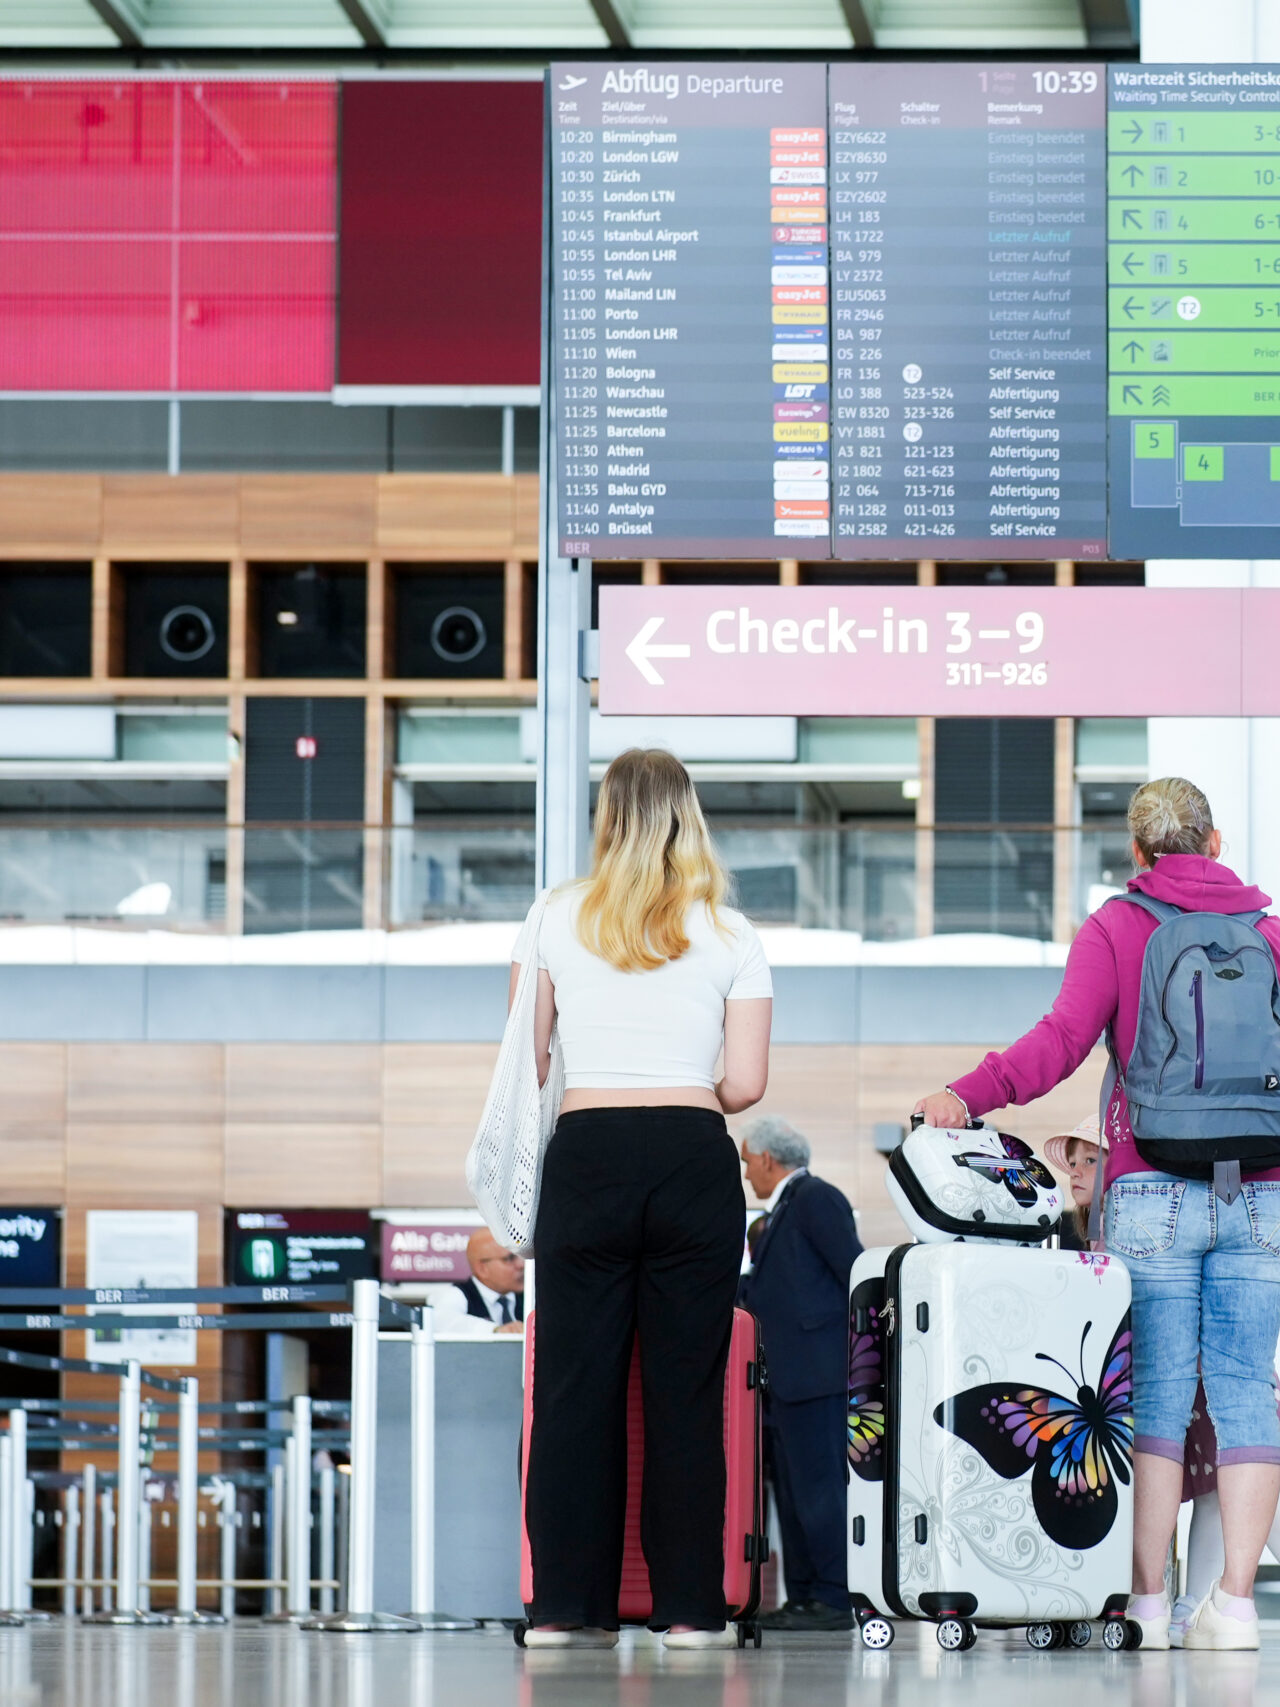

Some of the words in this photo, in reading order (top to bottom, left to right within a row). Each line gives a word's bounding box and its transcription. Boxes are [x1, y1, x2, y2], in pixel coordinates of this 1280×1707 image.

[602, 69, 679, 99] Abflug
[1032, 71, 1097, 93] 10:39
[1114, 72, 1184, 85] Wartezeit
[687, 75, 783, 98] Departure
[1114, 91, 1157, 104] Waiting
[1191, 91, 1236, 105] Security
[1239, 91, 1280, 102] Control
[559, 102, 577, 111] Zeit
[602, 102, 646, 112] Ziel/über
[835, 102, 856, 114] Flug
[901, 102, 940, 112] Schalter
[988, 102, 1043, 114] Bemerkung
[561, 131, 593, 143] 10:20
[603, 130, 677, 146] Birmingham
[775, 132, 819, 145] easyJet
[835, 132, 886, 144] EZY6622
[1178, 127, 1184, 142] 1
[603, 150, 648, 163] London
[651, 151, 679, 163] LGW
[603, 170, 640, 182] Zürich
[1178, 171, 1187, 187] 2
[603, 190, 648, 202] London
[652, 190, 675, 202] LTN
[604, 209, 661, 222] Frankfurt
[1178, 215, 1188, 231] 4
[604, 229, 653, 241] Istanbul
[656, 229, 698, 244] Airport
[604, 249, 649, 261] London
[652, 249, 676, 261] LHR
[1178, 259, 1187, 275] 5
[604, 268, 623, 280] Tel
[626, 268, 652, 281] Aviv
[605, 288, 653, 300] Mailand
[656, 289, 676, 300] LIN
[605, 308, 639, 320] Porto
[1181, 300, 1198, 316] T2
[605, 346, 636, 359] Wien
[606, 366, 655, 381] Bologna
[606, 386, 664, 398] Warschau
[904, 387, 953, 399] 523-524
[989, 387, 1059, 402] Abfertigung
[1254, 392, 1275, 401] BER
[607, 405, 667, 418] Newcastle
[607, 425, 666, 437] Barcelona
[779, 426, 819, 439] vueling
[1150, 432, 1159, 448] 5
[607, 444, 643, 457] Athen
[778, 446, 815, 454] AEGEAN
[1198, 454, 1209, 471] 4
[608, 463, 650, 476] Madrid
[904, 465, 954, 477] 621-623
[608, 483, 638, 495] Baku
[641, 483, 666, 496] GYD
[905, 485, 955, 496] 713-716
[608, 502, 654, 518] Antalya
[609, 522, 653, 534] Brüssel
[566, 542, 589, 553] BER
[707, 607, 927, 653] Check-in
[0, 1214, 46, 1241] ority
[392, 1232, 428, 1251] Alle
[431, 1233, 467, 1251] Gat
[392, 1255, 412, 1270] All
[413, 1255, 453, 1270] Gates
[96, 1290, 121, 1302] BER
[263, 1288, 288, 1300] BER
[27, 1316, 50, 1327] BER
[178, 1315, 203, 1328] BER
[330, 1314, 353, 1326] BER
